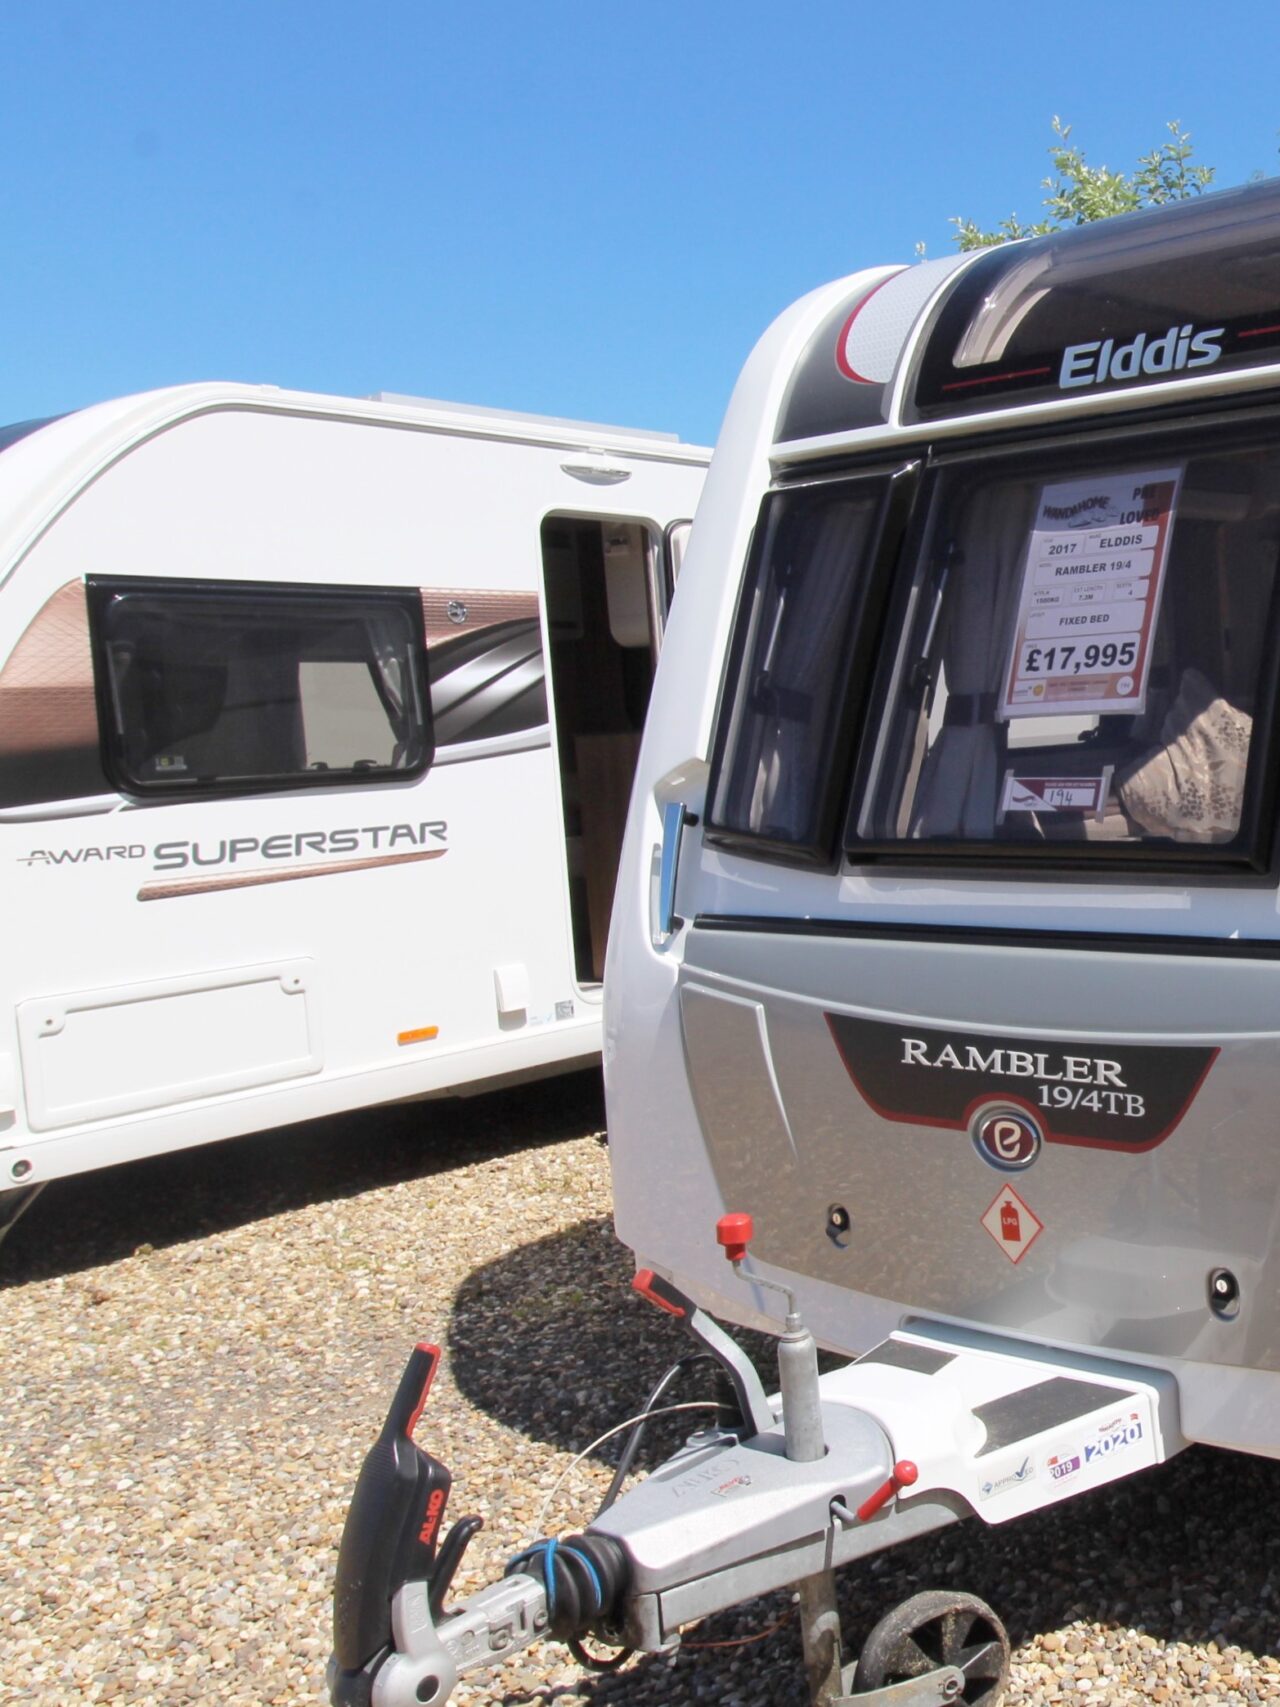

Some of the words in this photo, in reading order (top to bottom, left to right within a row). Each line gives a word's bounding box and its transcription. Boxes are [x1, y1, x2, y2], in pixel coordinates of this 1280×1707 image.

[1059, 324, 1225, 389] Elddis
[1048, 543, 1077, 556] 2017
[1099, 534, 1143, 549] ELDDIS
[1055, 563, 1107, 577] RAMBLER
[1110, 560, 1132, 572] 19/4
[1059, 616, 1088, 626] FIXED
[1090, 614, 1110, 624] BED
[1025, 642, 1136, 674] £17,995
[1050, 788, 1073, 808] 194
[16, 844, 146, 866] AWARD
[153, 820, 448, 871] SUPERSTAR
[901, 1038, 1127, 1087] RAMBLER
[1038, 1085, 1146, 1117] 19/4TB
[1002, 1216, 1018, 1226] LPG
[1085, 1423, 1142, 1463] 2020
[1049, 1460, 1074, 1478] 2019
[418, 1488, 444, 1545] AL-KO
